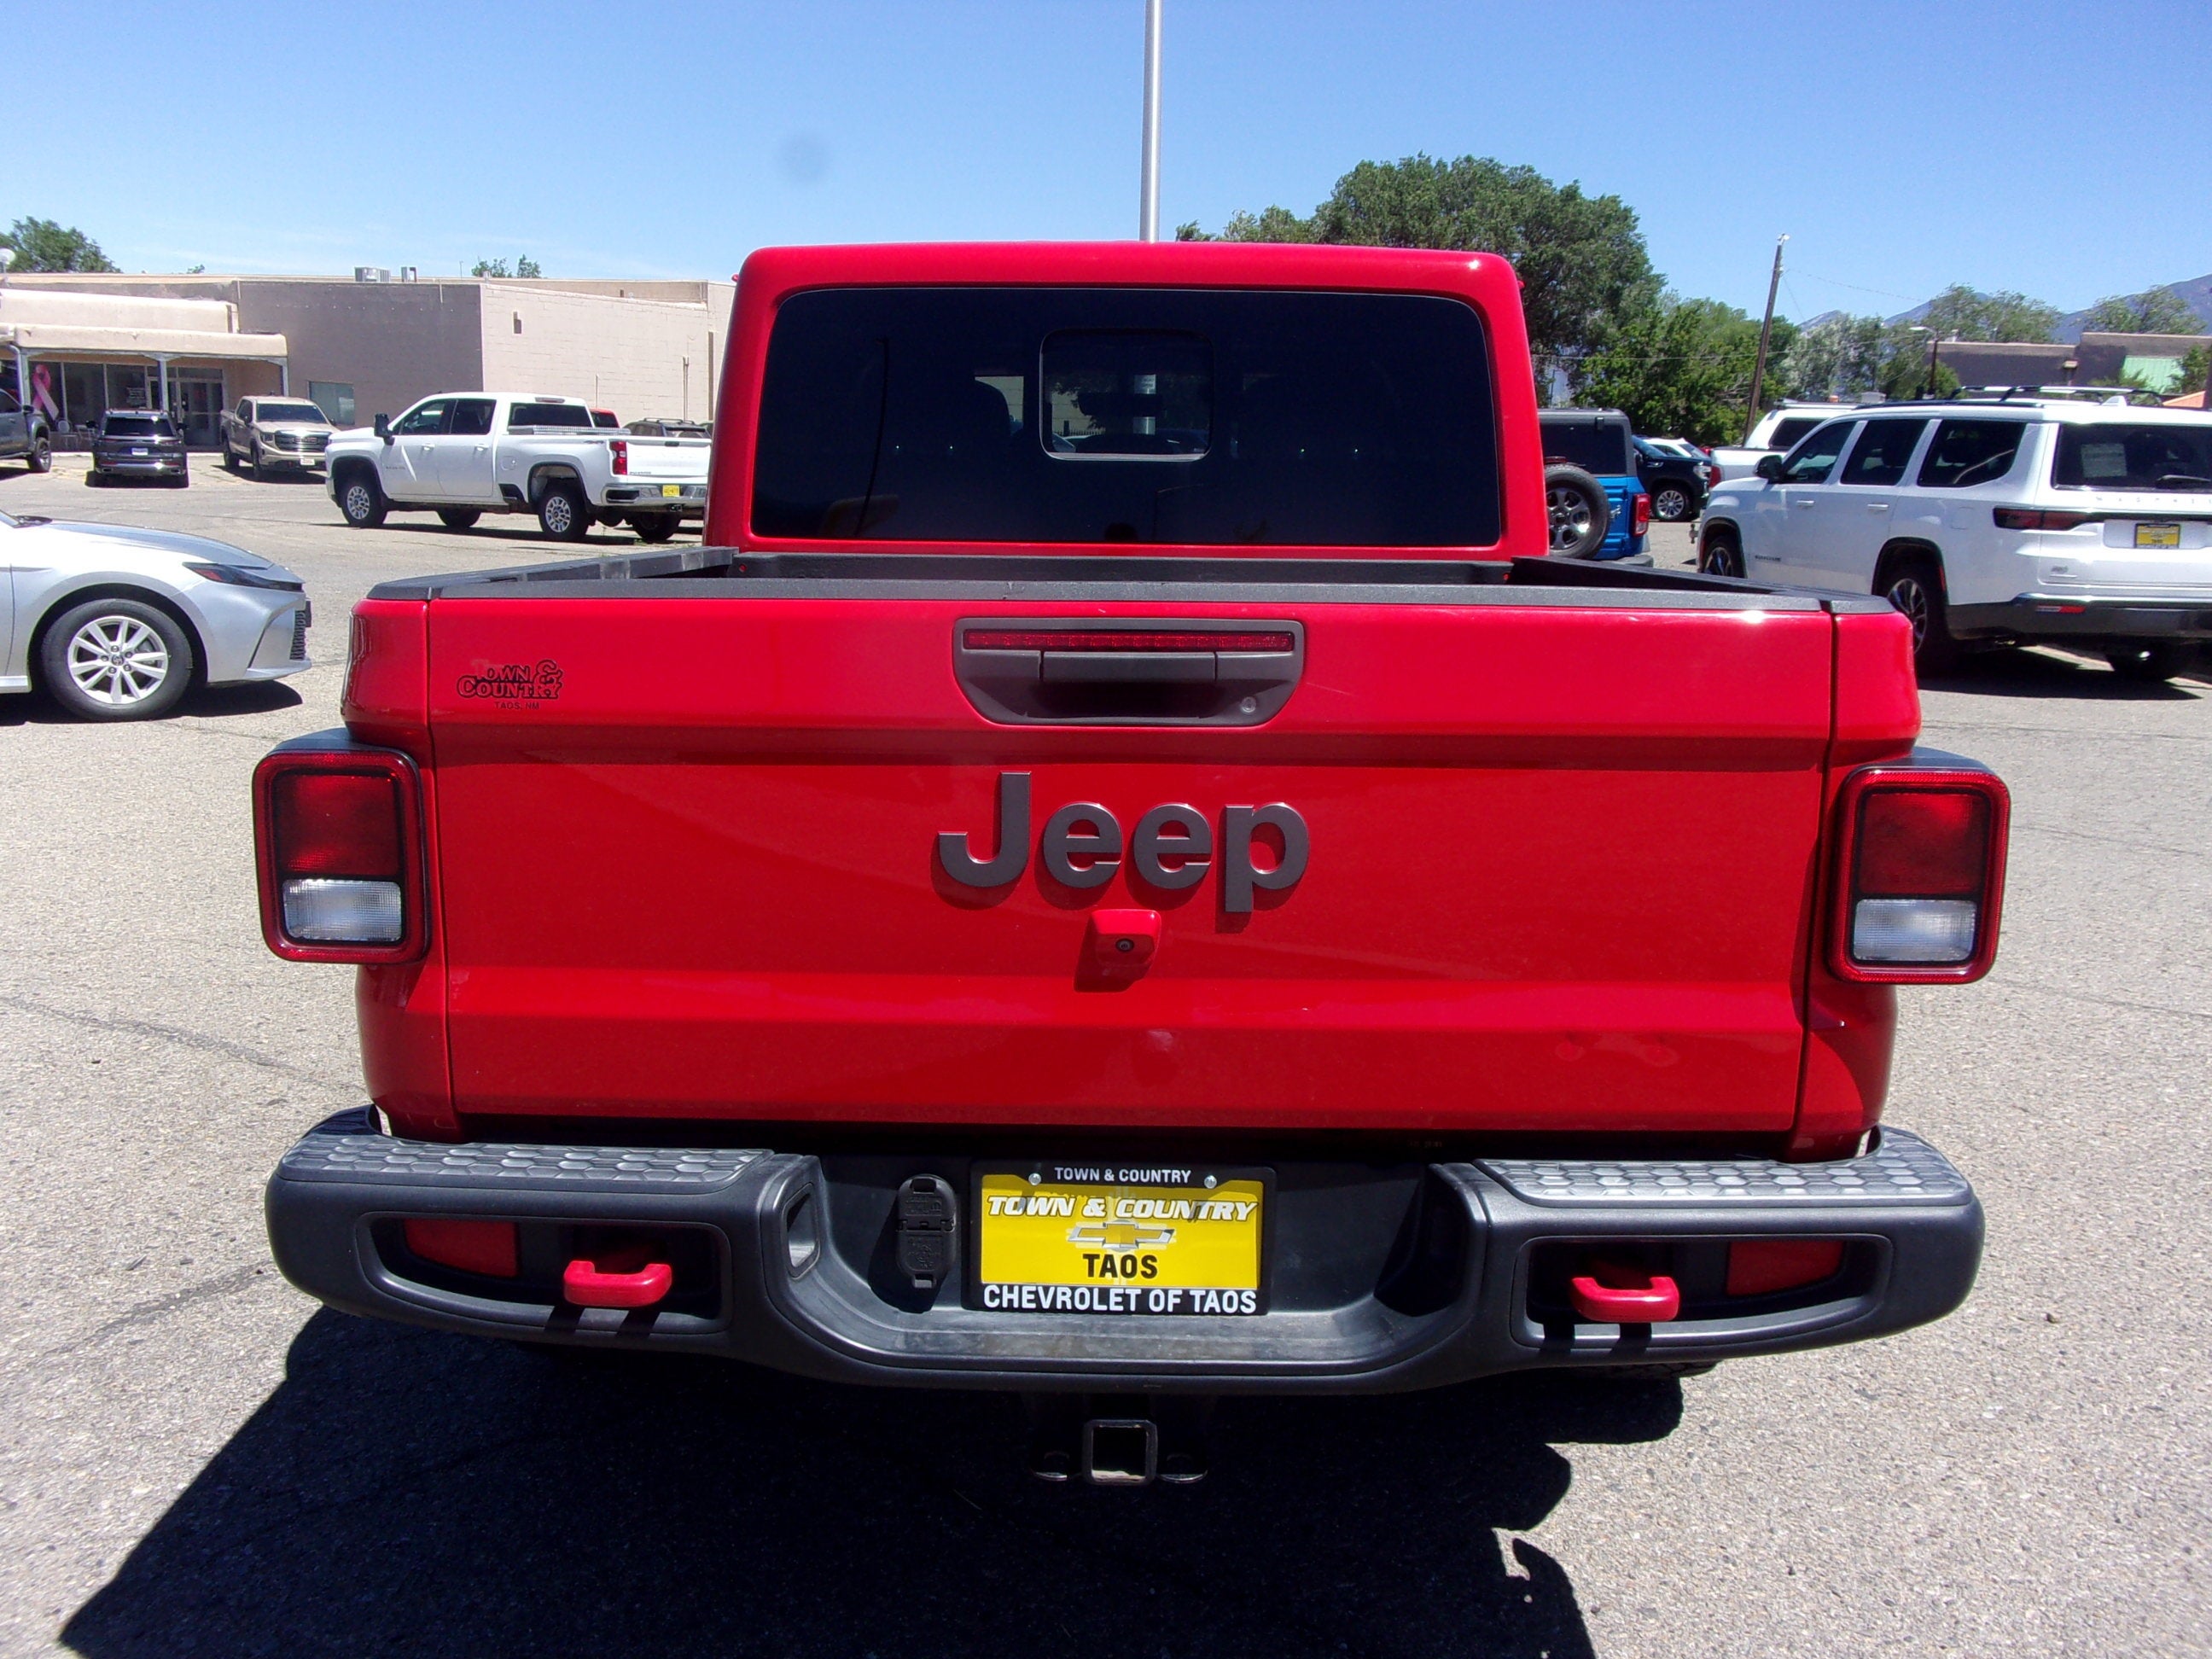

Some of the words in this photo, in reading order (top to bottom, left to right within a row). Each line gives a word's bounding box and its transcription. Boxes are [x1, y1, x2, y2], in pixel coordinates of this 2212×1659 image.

[535, 659, 562, 684] &
[457, 675, 562, 699] COUNTRY
[939, 771, 1310, 912] Jeep
[1055, 1167, 1099, 1181] TOWN
[1104, 1168, 1115, 1182] &
[1119, 1169, 1191, 1183] COUNTRY
[988, 1196, 1075, 1216] TOWN
[1082, 1197, 1107, 1218] &
[1115, 1199, 1258, 1221] COUNTRY
[1083, 1254, 1158, 1279] TAOS
[984, 1284, 1142, 1312] CHEVROLET
[1149, 1289, 1183, 1313] OF
[1190, 1289, 1257, 1314] TAOS
